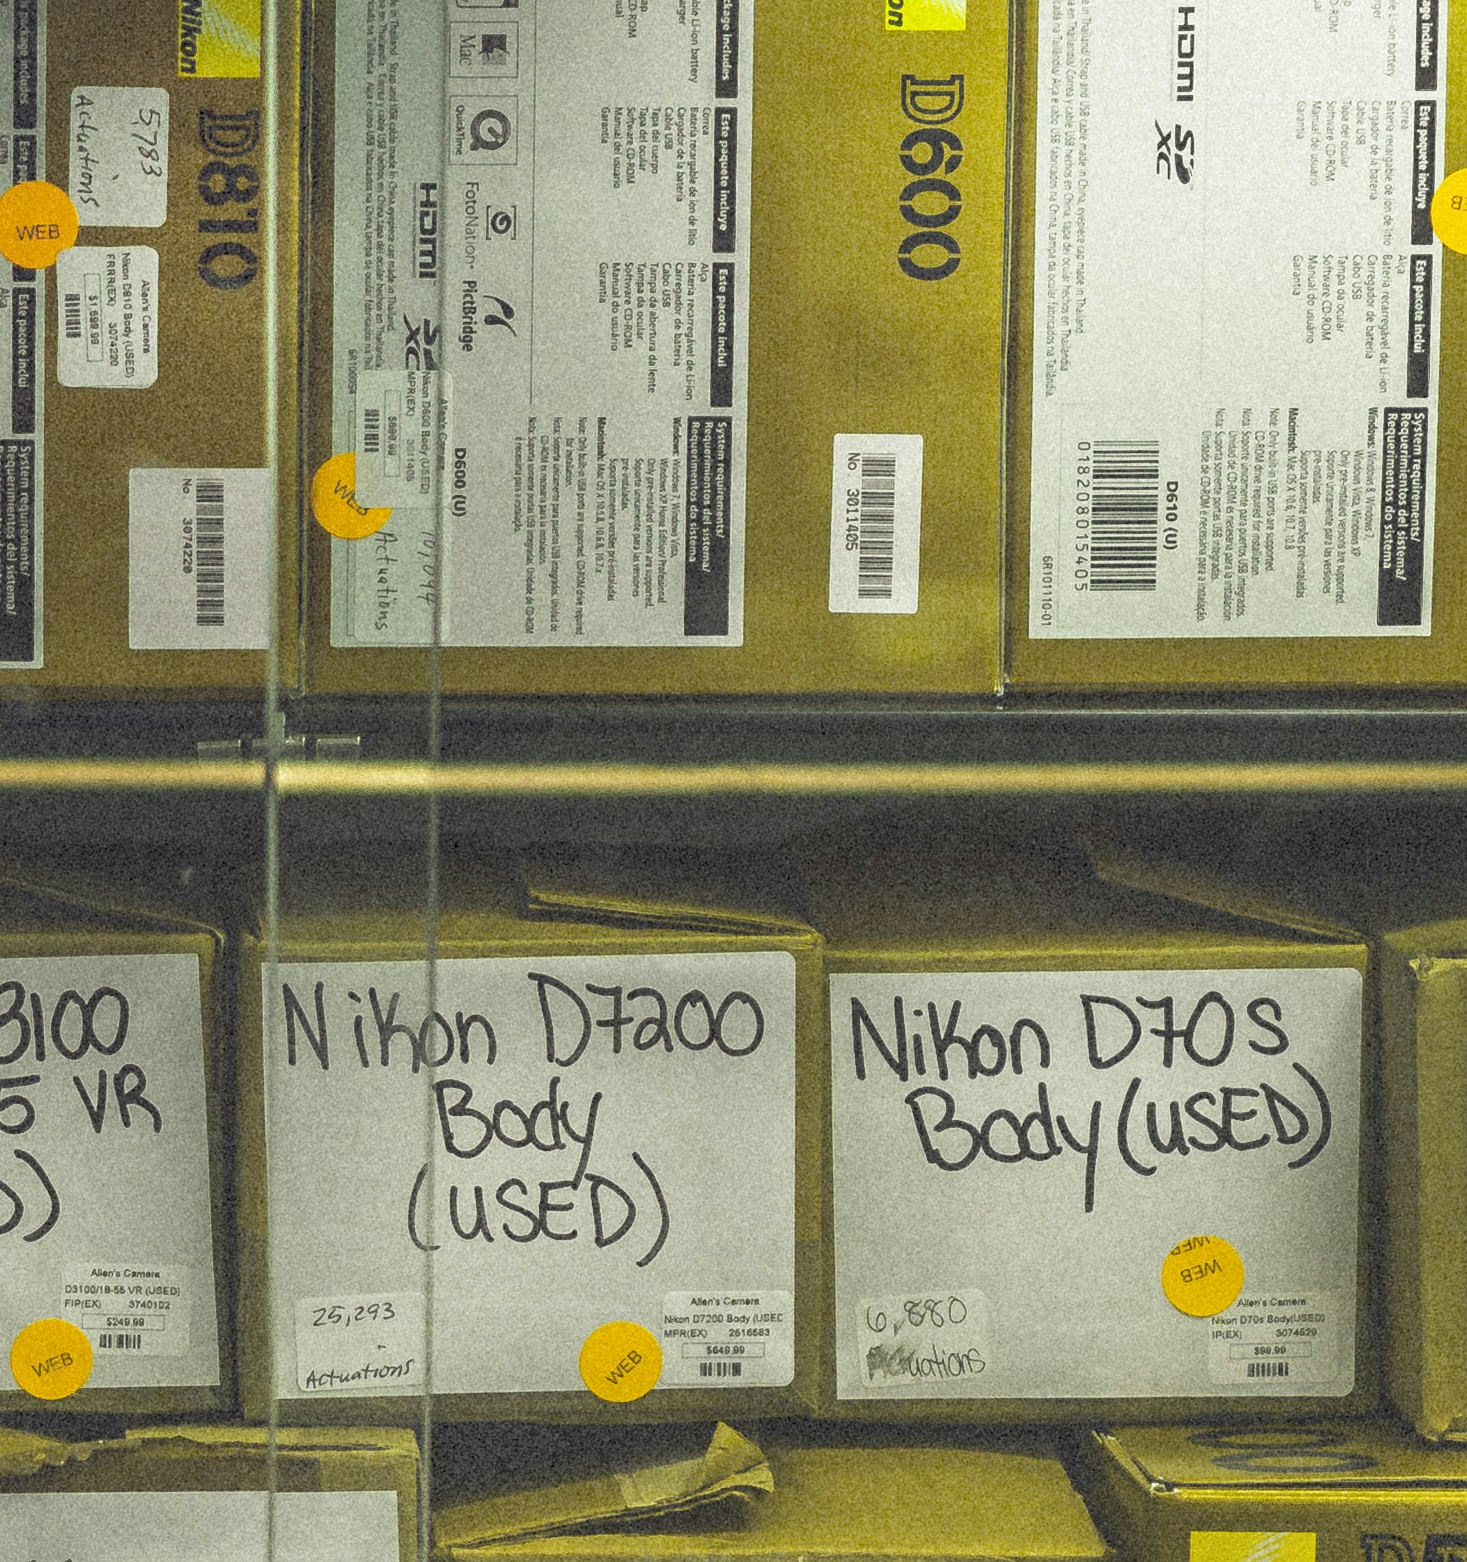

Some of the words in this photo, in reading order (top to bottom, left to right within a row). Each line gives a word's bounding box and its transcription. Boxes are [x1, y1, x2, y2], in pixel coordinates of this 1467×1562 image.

[1177, 6, 1195, 103] HDMI
[75, 93, 102, 207] Actuations
[897, 73, 964, 282] D600
[16, 225, 60, 241] WEB
[197, 108, 259, 290] D810
[142, 315, 152, 354] Camera
[462, 280, 478, 352] PictBridge
[454, 448, 467, 492] D600
[281, 980, 497, 1074] Nikon
[527, 971, 764, 1067] D7200
[851, 995, 1051, 1082] Nikon
[71, 1063, 163, 1135] VR
[433, 1074, 604, 1190] Body
[905, 1080, 1103, 1212] Body
[1117, 1061, 1331, 1177] (USED)
[406, 1150, 671, 1268] (USED)
[124, 1268, 161, 1279] Camera
[310, 1301, 396, 1328] 25,293
[30, 1351, 75, 1379] WEB
